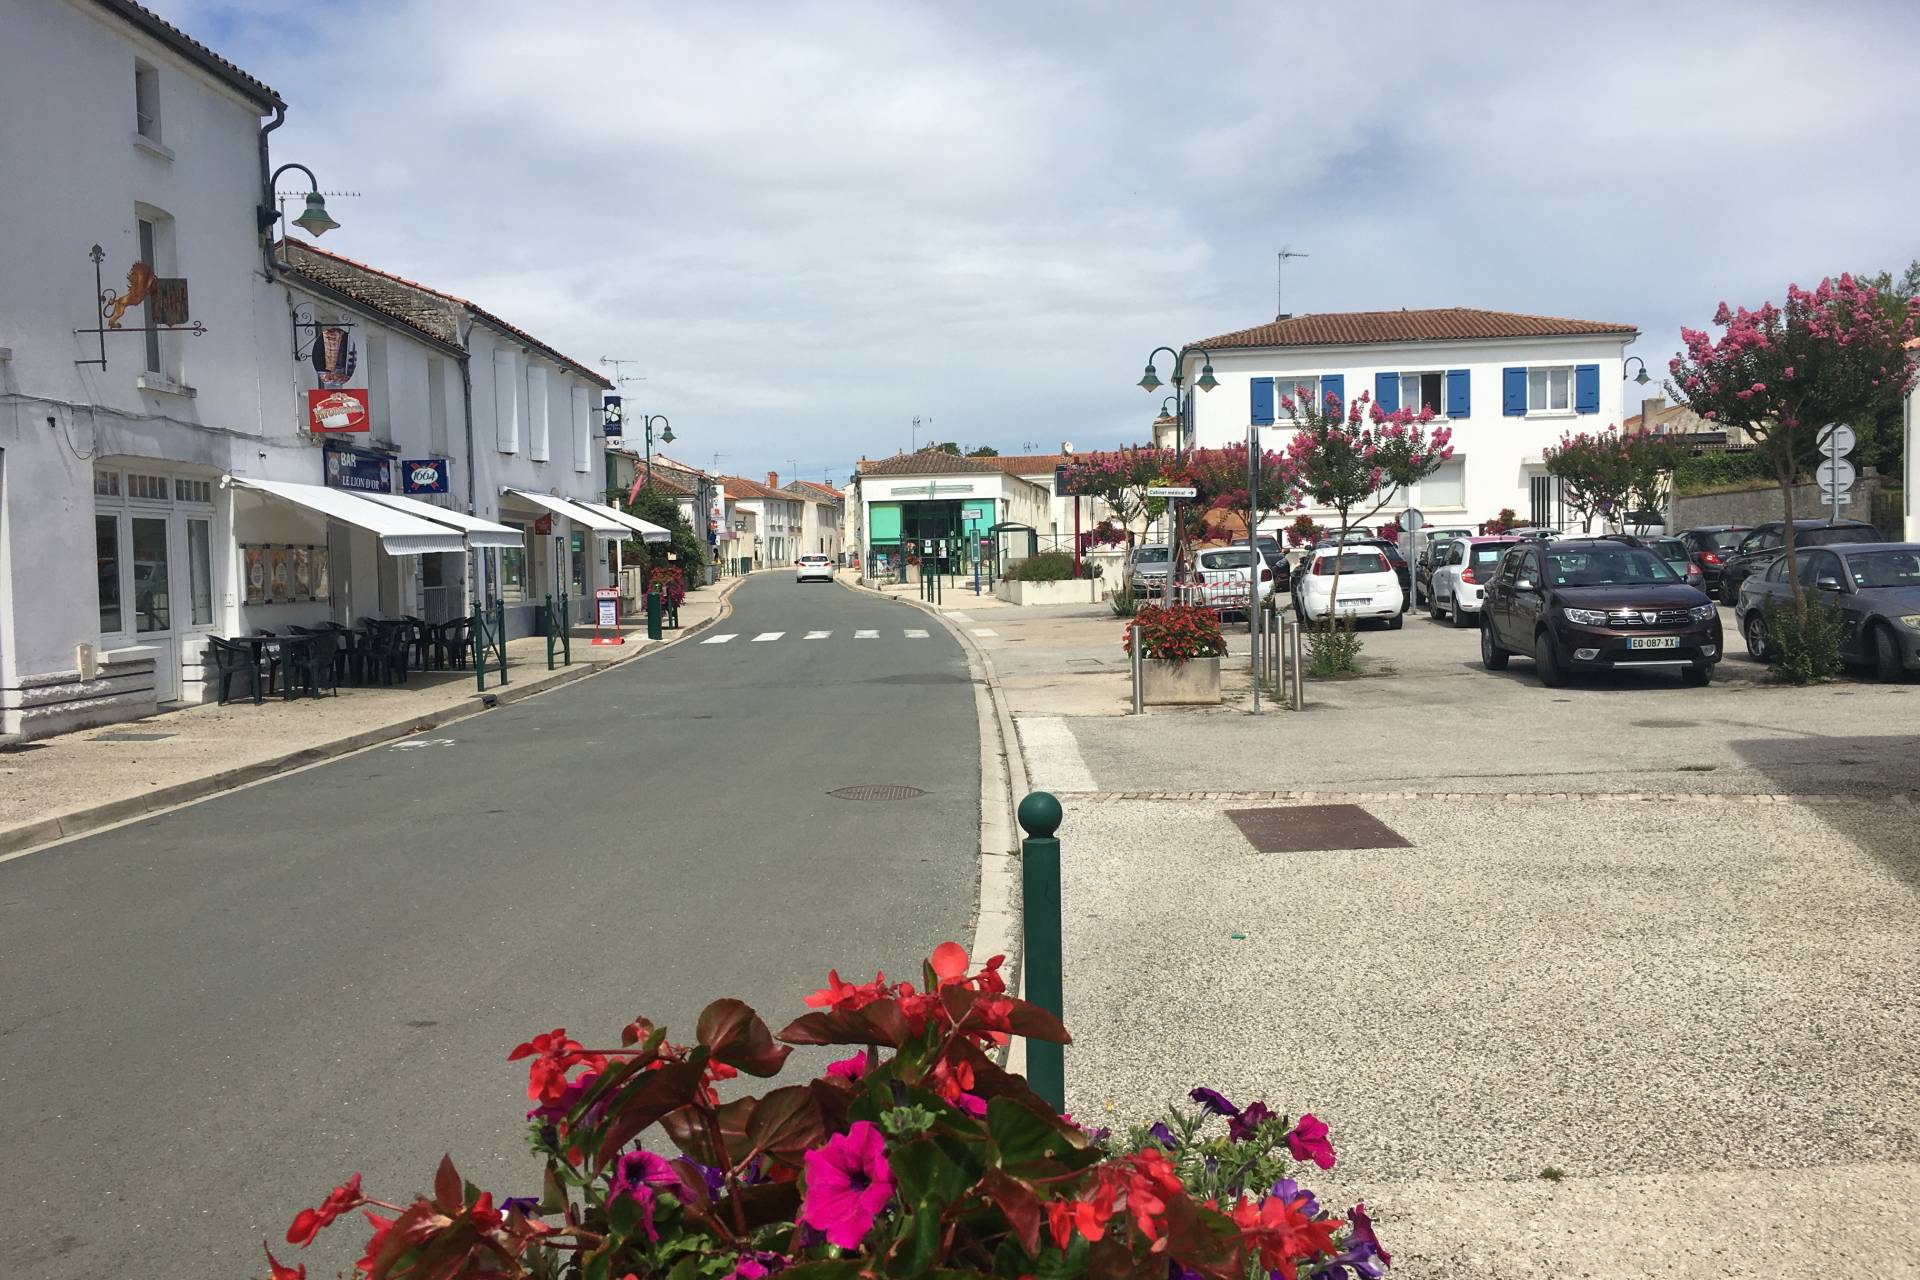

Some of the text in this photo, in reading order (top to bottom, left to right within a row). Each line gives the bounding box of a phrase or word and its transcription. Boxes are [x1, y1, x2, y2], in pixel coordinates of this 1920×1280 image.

[340, 452, 357, 468] BAR
[342, 475, 350, 486] LE
[350, 477, 365, 488] LION
[413, 470, 436, 481] 1664
